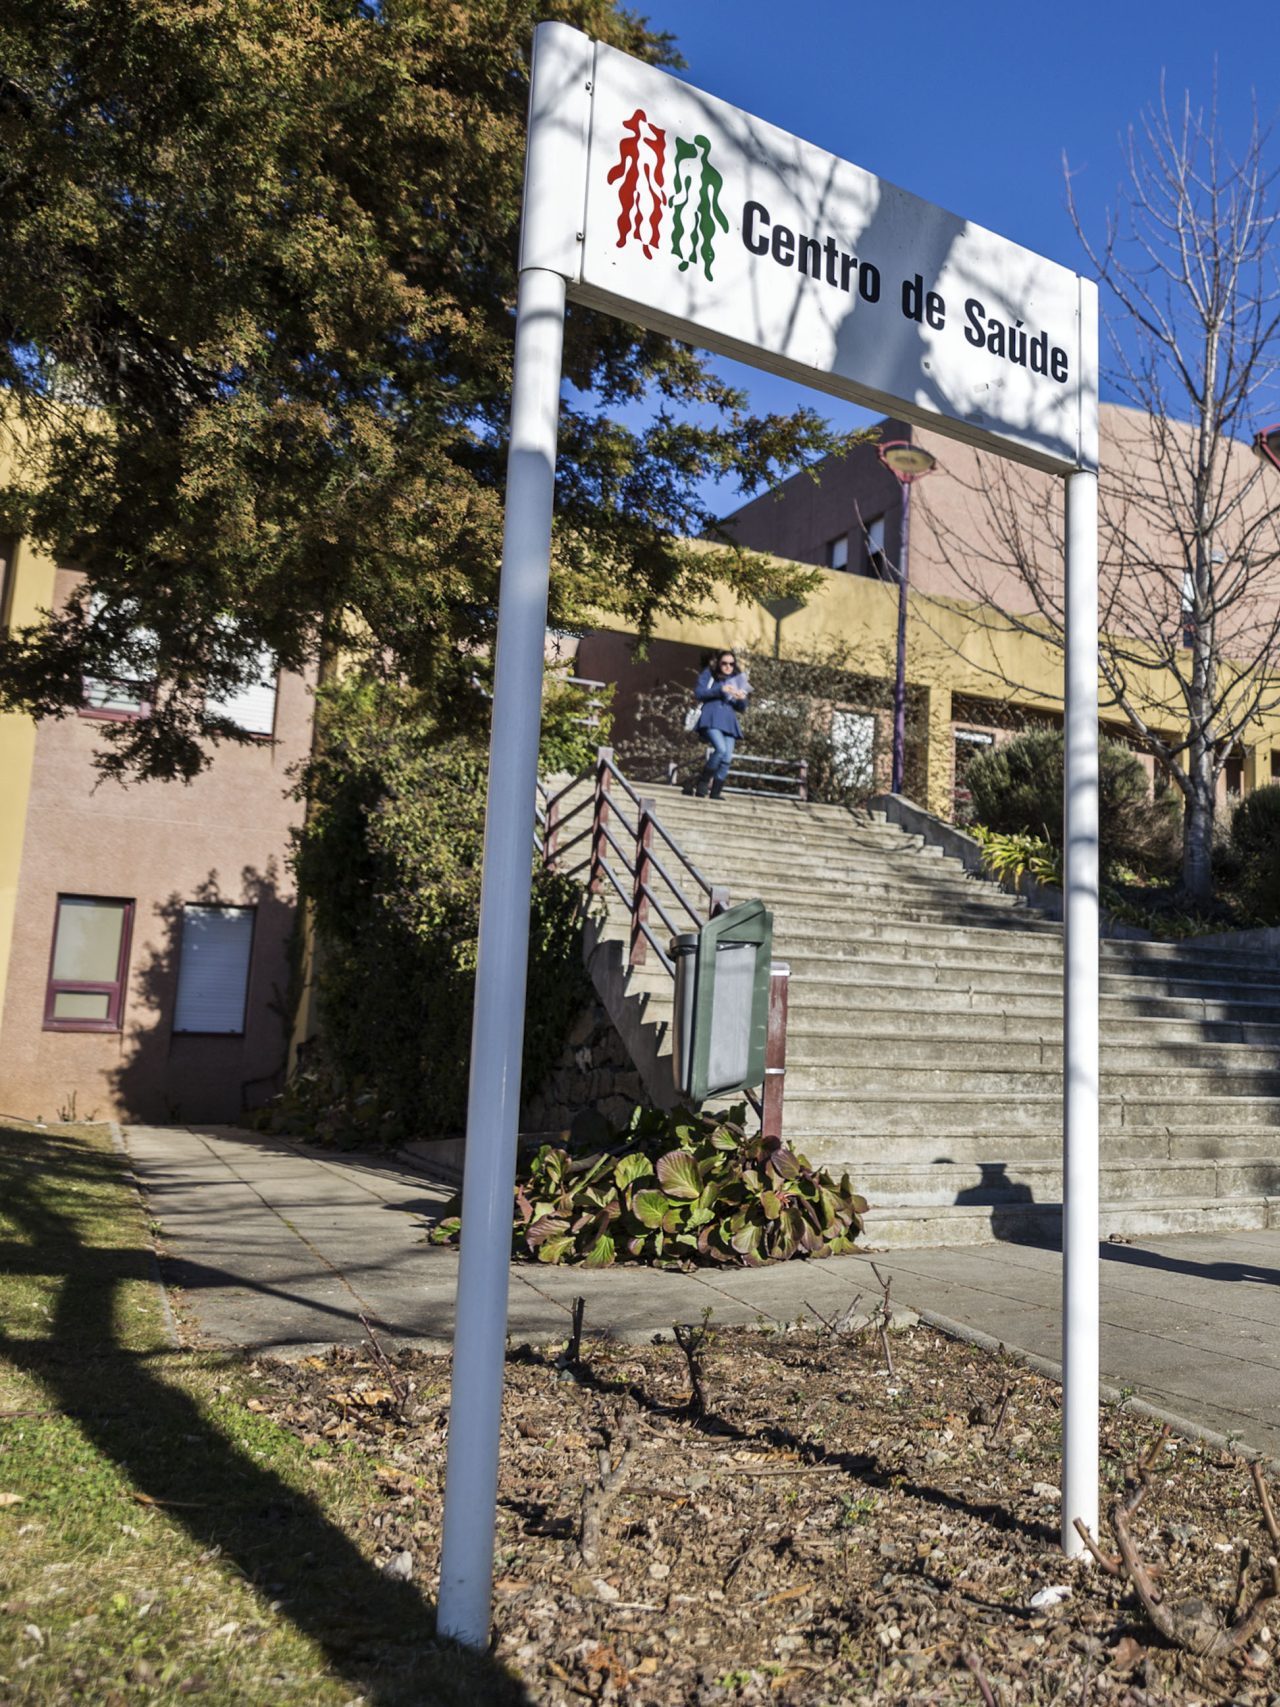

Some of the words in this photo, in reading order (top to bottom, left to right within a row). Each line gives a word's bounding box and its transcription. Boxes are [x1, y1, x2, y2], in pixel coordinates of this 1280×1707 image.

[742, 200, 880, 303] Centro
[902, 274, 945, 331] de
[964, 298, 1069, 384] Saúde
